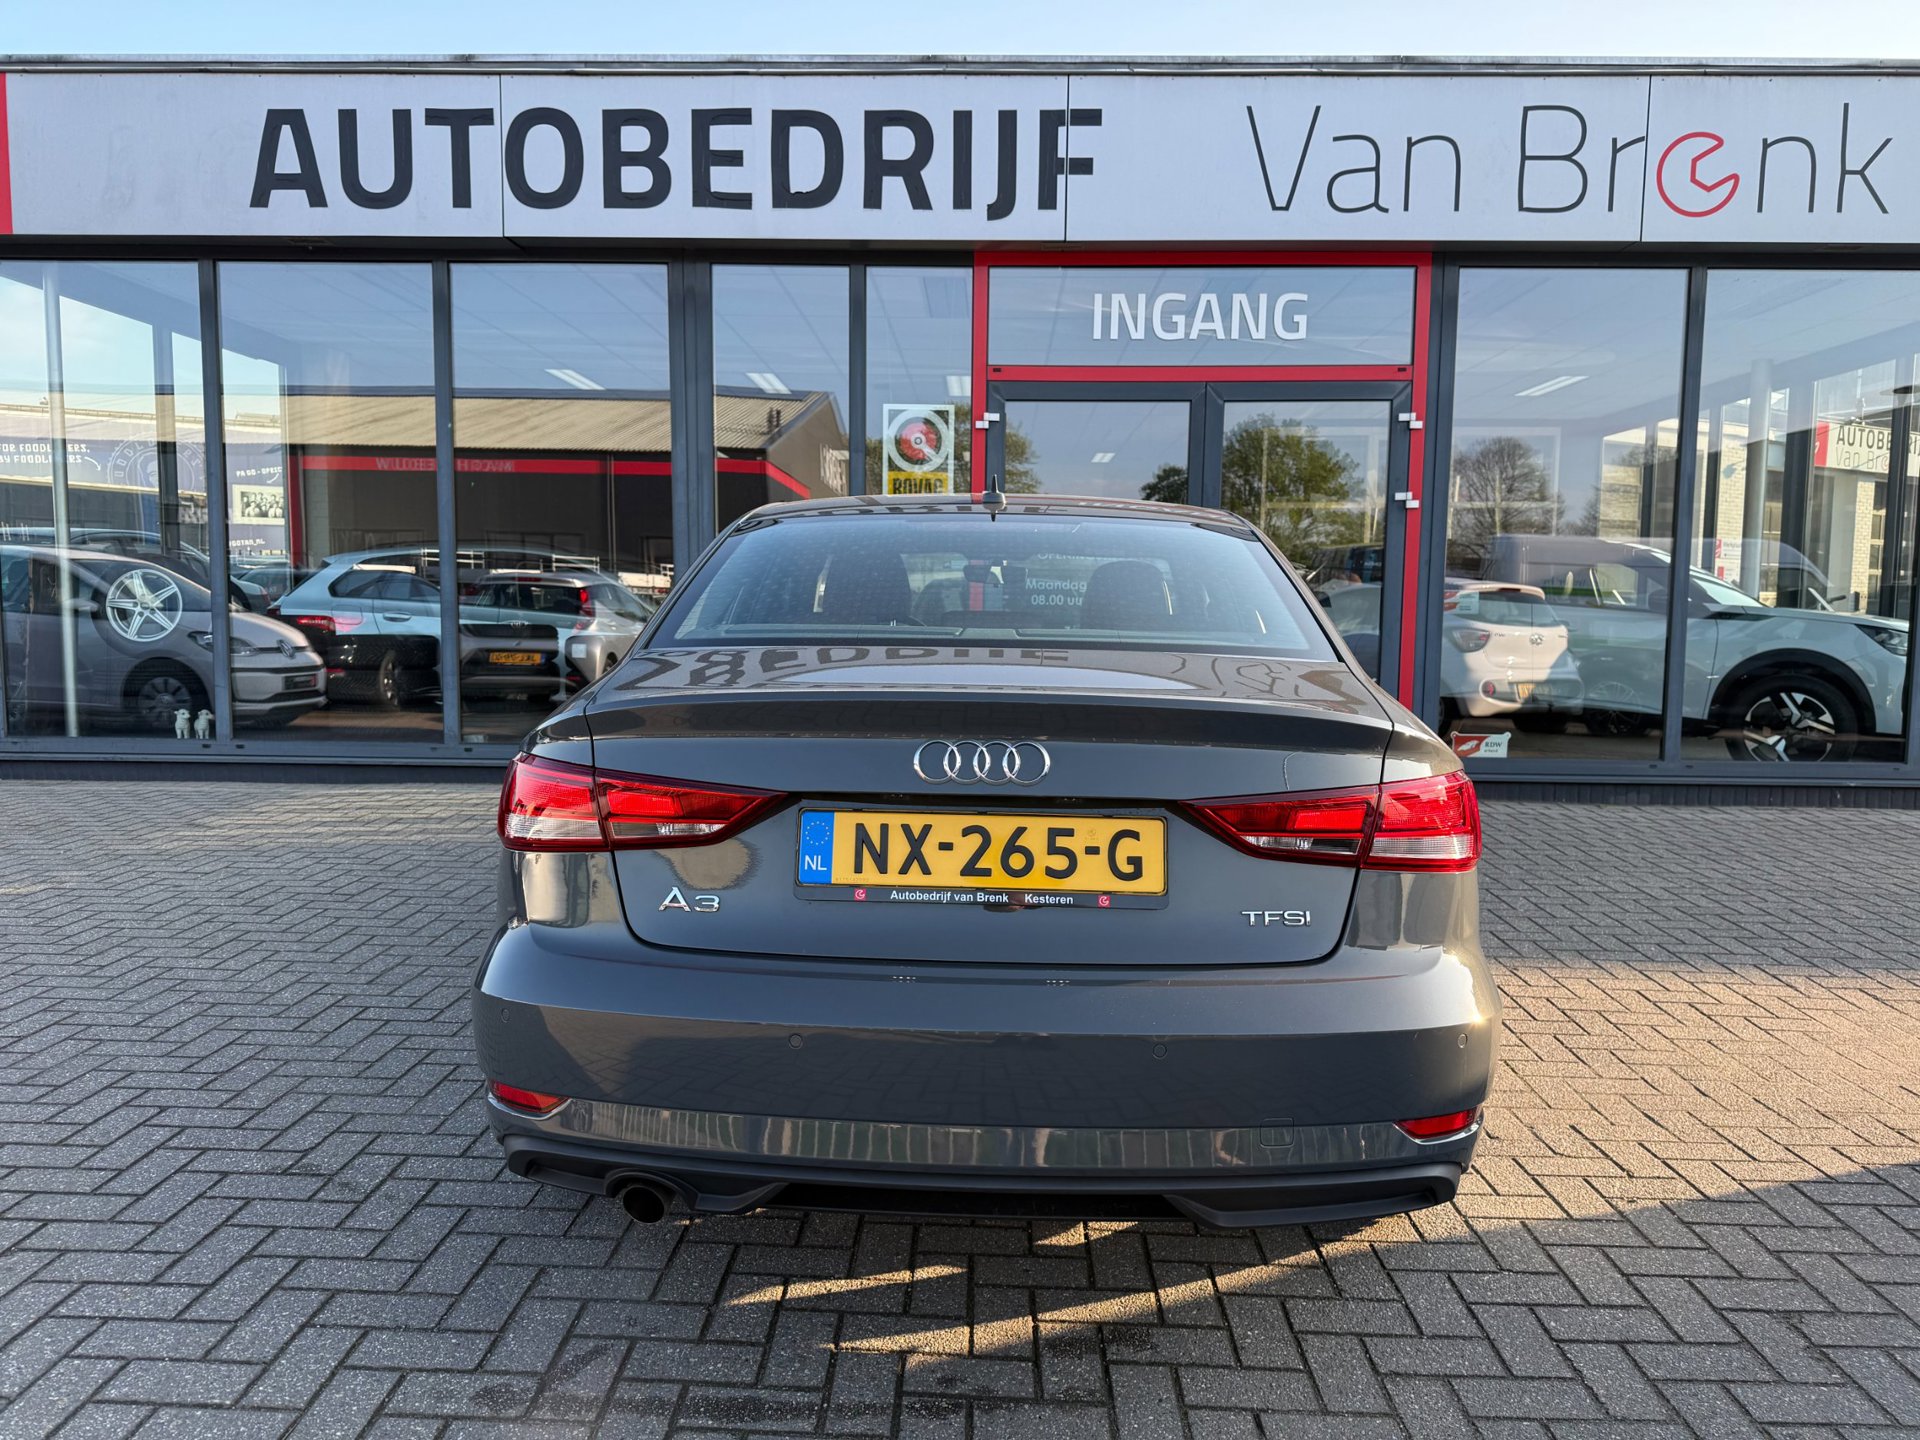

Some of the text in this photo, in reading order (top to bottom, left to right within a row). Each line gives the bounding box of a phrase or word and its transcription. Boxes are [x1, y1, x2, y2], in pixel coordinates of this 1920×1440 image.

[249, 106, 1103, 221] AUTOBEDRIJF
[1246, 105, 1462, 213] Van
[1092, 293, 1309, 340] INGANG
[1025, 579, 1087, 593] Maandag
[1031, 594, 1064, 605] 08.00
[854, 823, 1143, 881] NX-265-G
[804, 855, 827, 870] NL
[658, 886, 721, 912] A3
[890, 890, 1074, 905] Autobedrijf van Brenk Kesteren
[1241, 910, 1311, 926] TFSI
